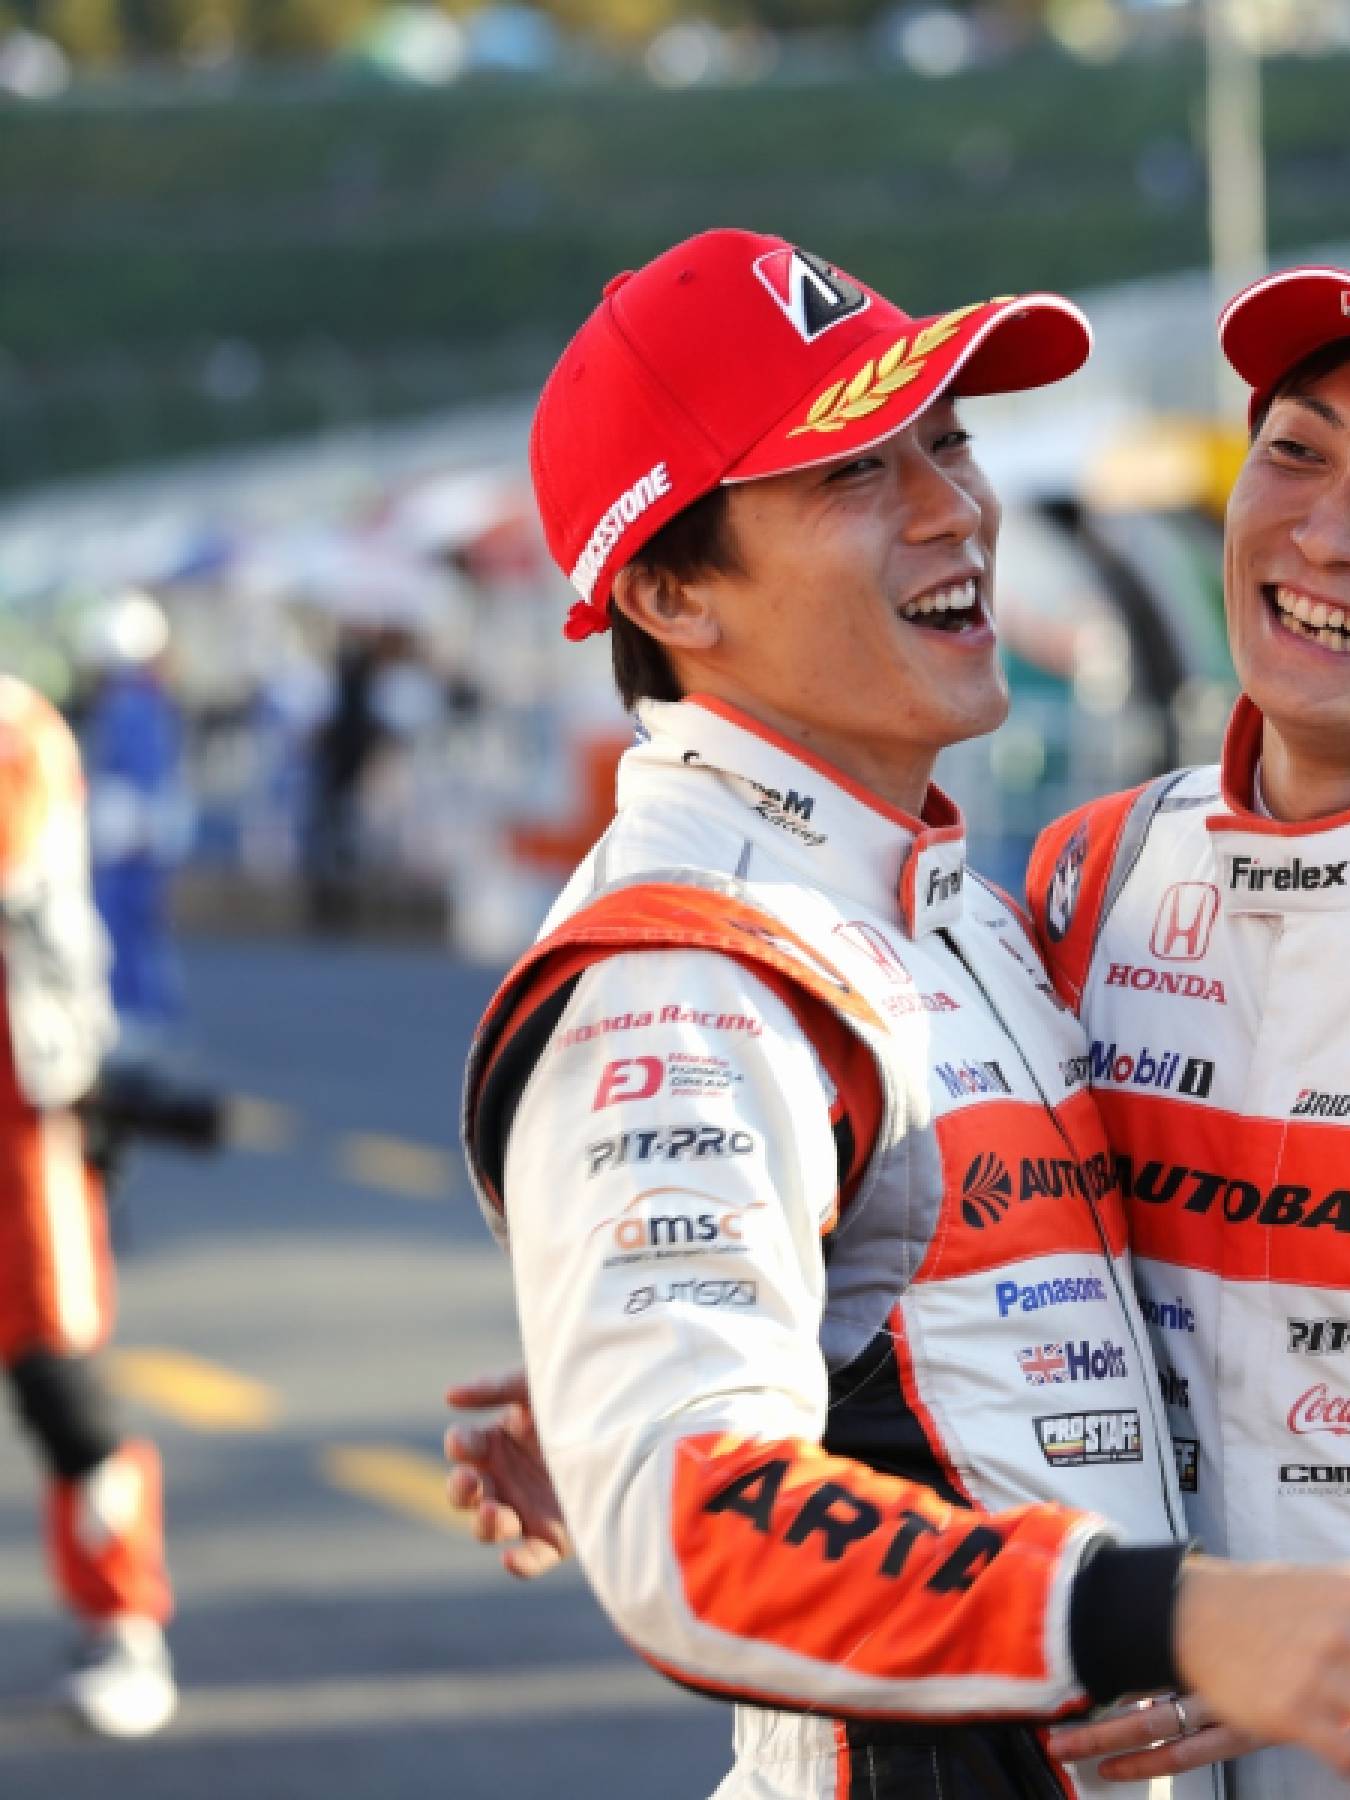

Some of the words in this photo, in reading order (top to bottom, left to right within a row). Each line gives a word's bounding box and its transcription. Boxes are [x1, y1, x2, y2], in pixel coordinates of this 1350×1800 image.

[1230, 858, 1350, 891] Firelex
[1103, 961, 1229, 1006] HONDA
[659, 1004, 763, 1037] Racing
[1089, 1041, 1180, 1089] Mobil
[704, 1459, 1004, 1594] ARTA
